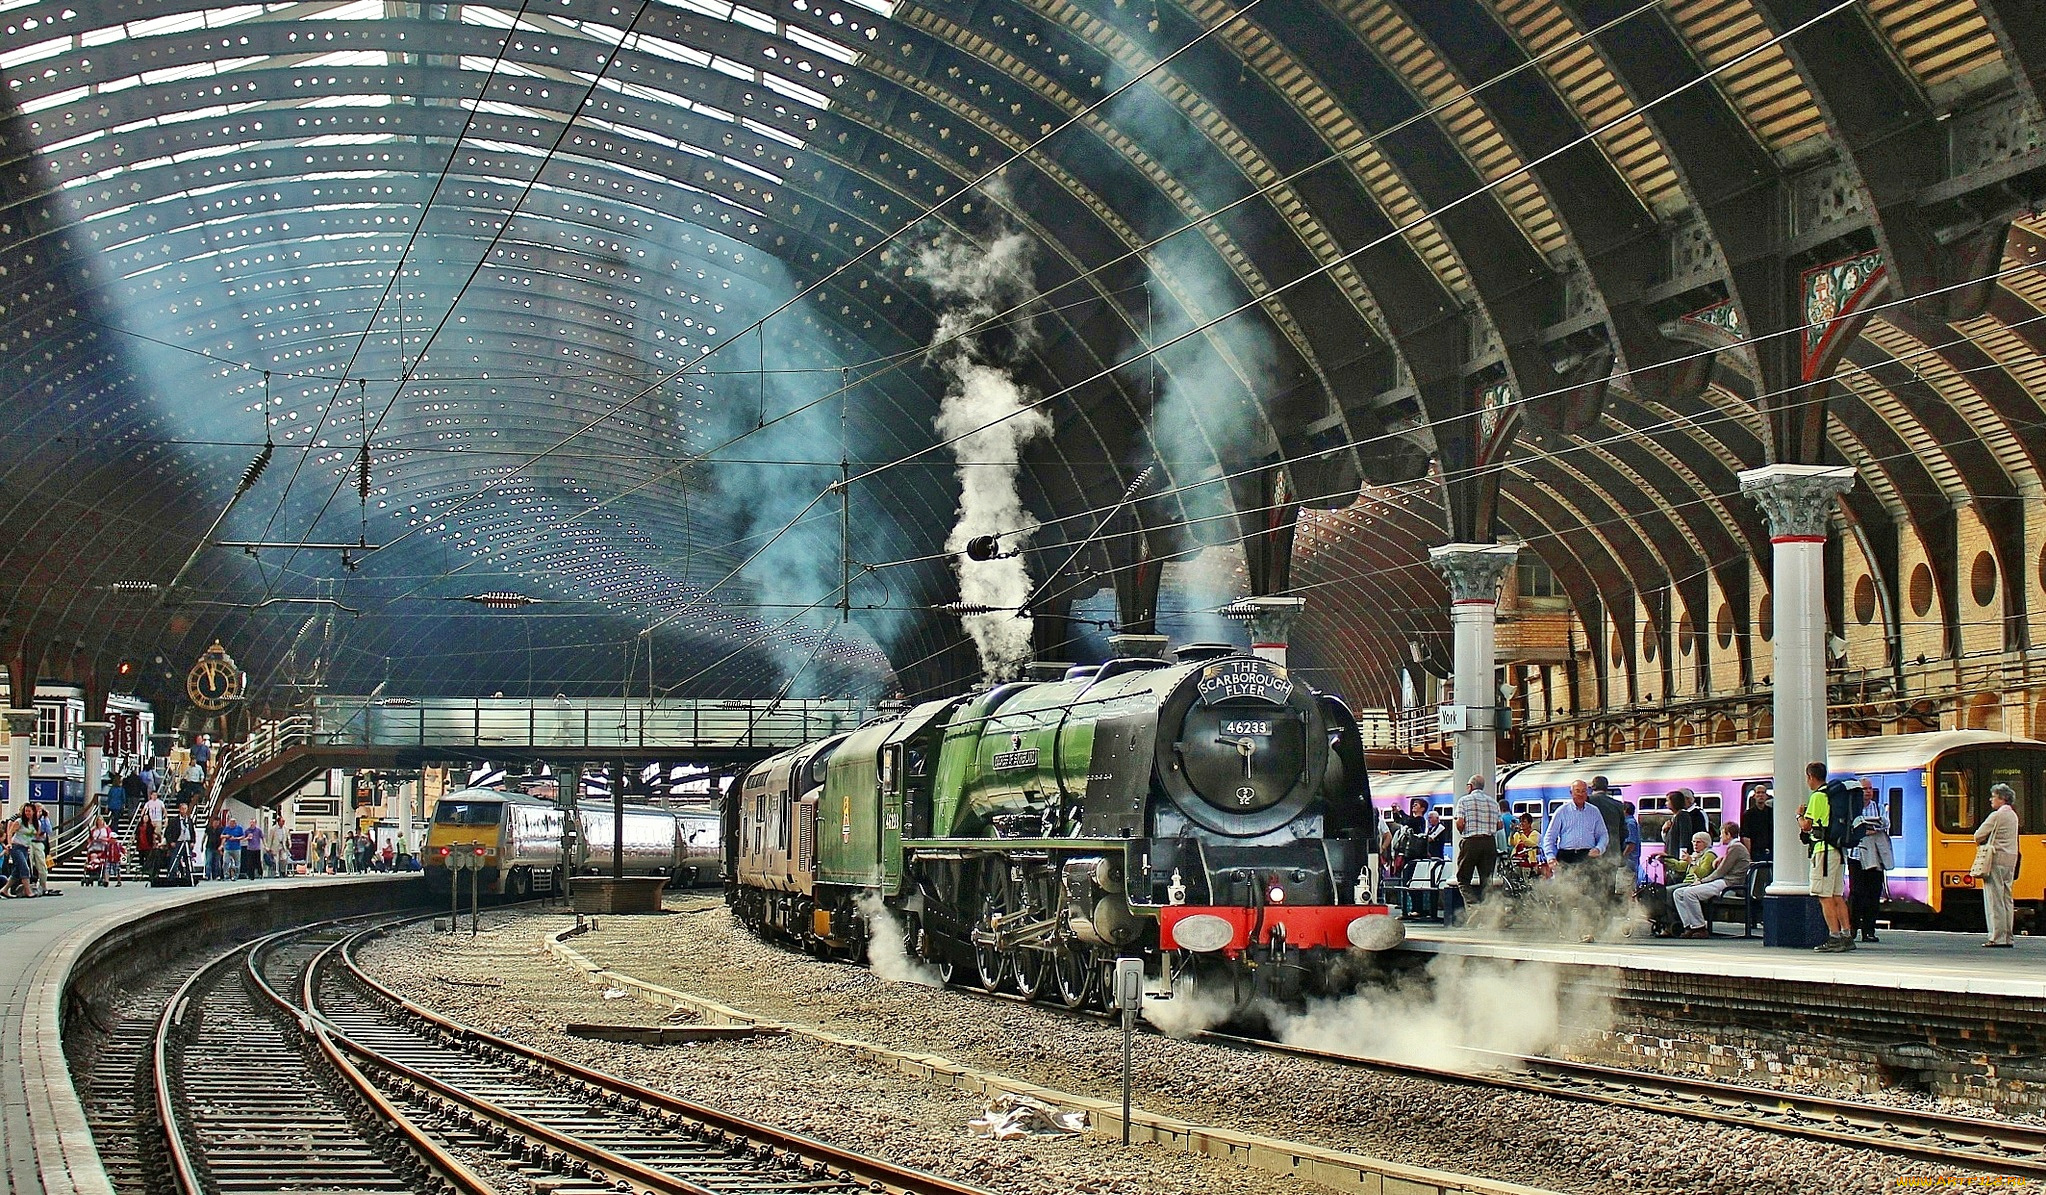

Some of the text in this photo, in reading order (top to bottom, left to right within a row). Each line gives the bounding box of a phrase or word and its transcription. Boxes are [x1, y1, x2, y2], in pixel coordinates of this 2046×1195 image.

[1231, 662, 1259, 673] THE
[1200, 673, 1291, 694] SCARBOROUGH
[1225, 684, 1265, 696] FLYER
[1442, 710, 1457, 725] York
[1226, 721, 1267, 734] 46233
